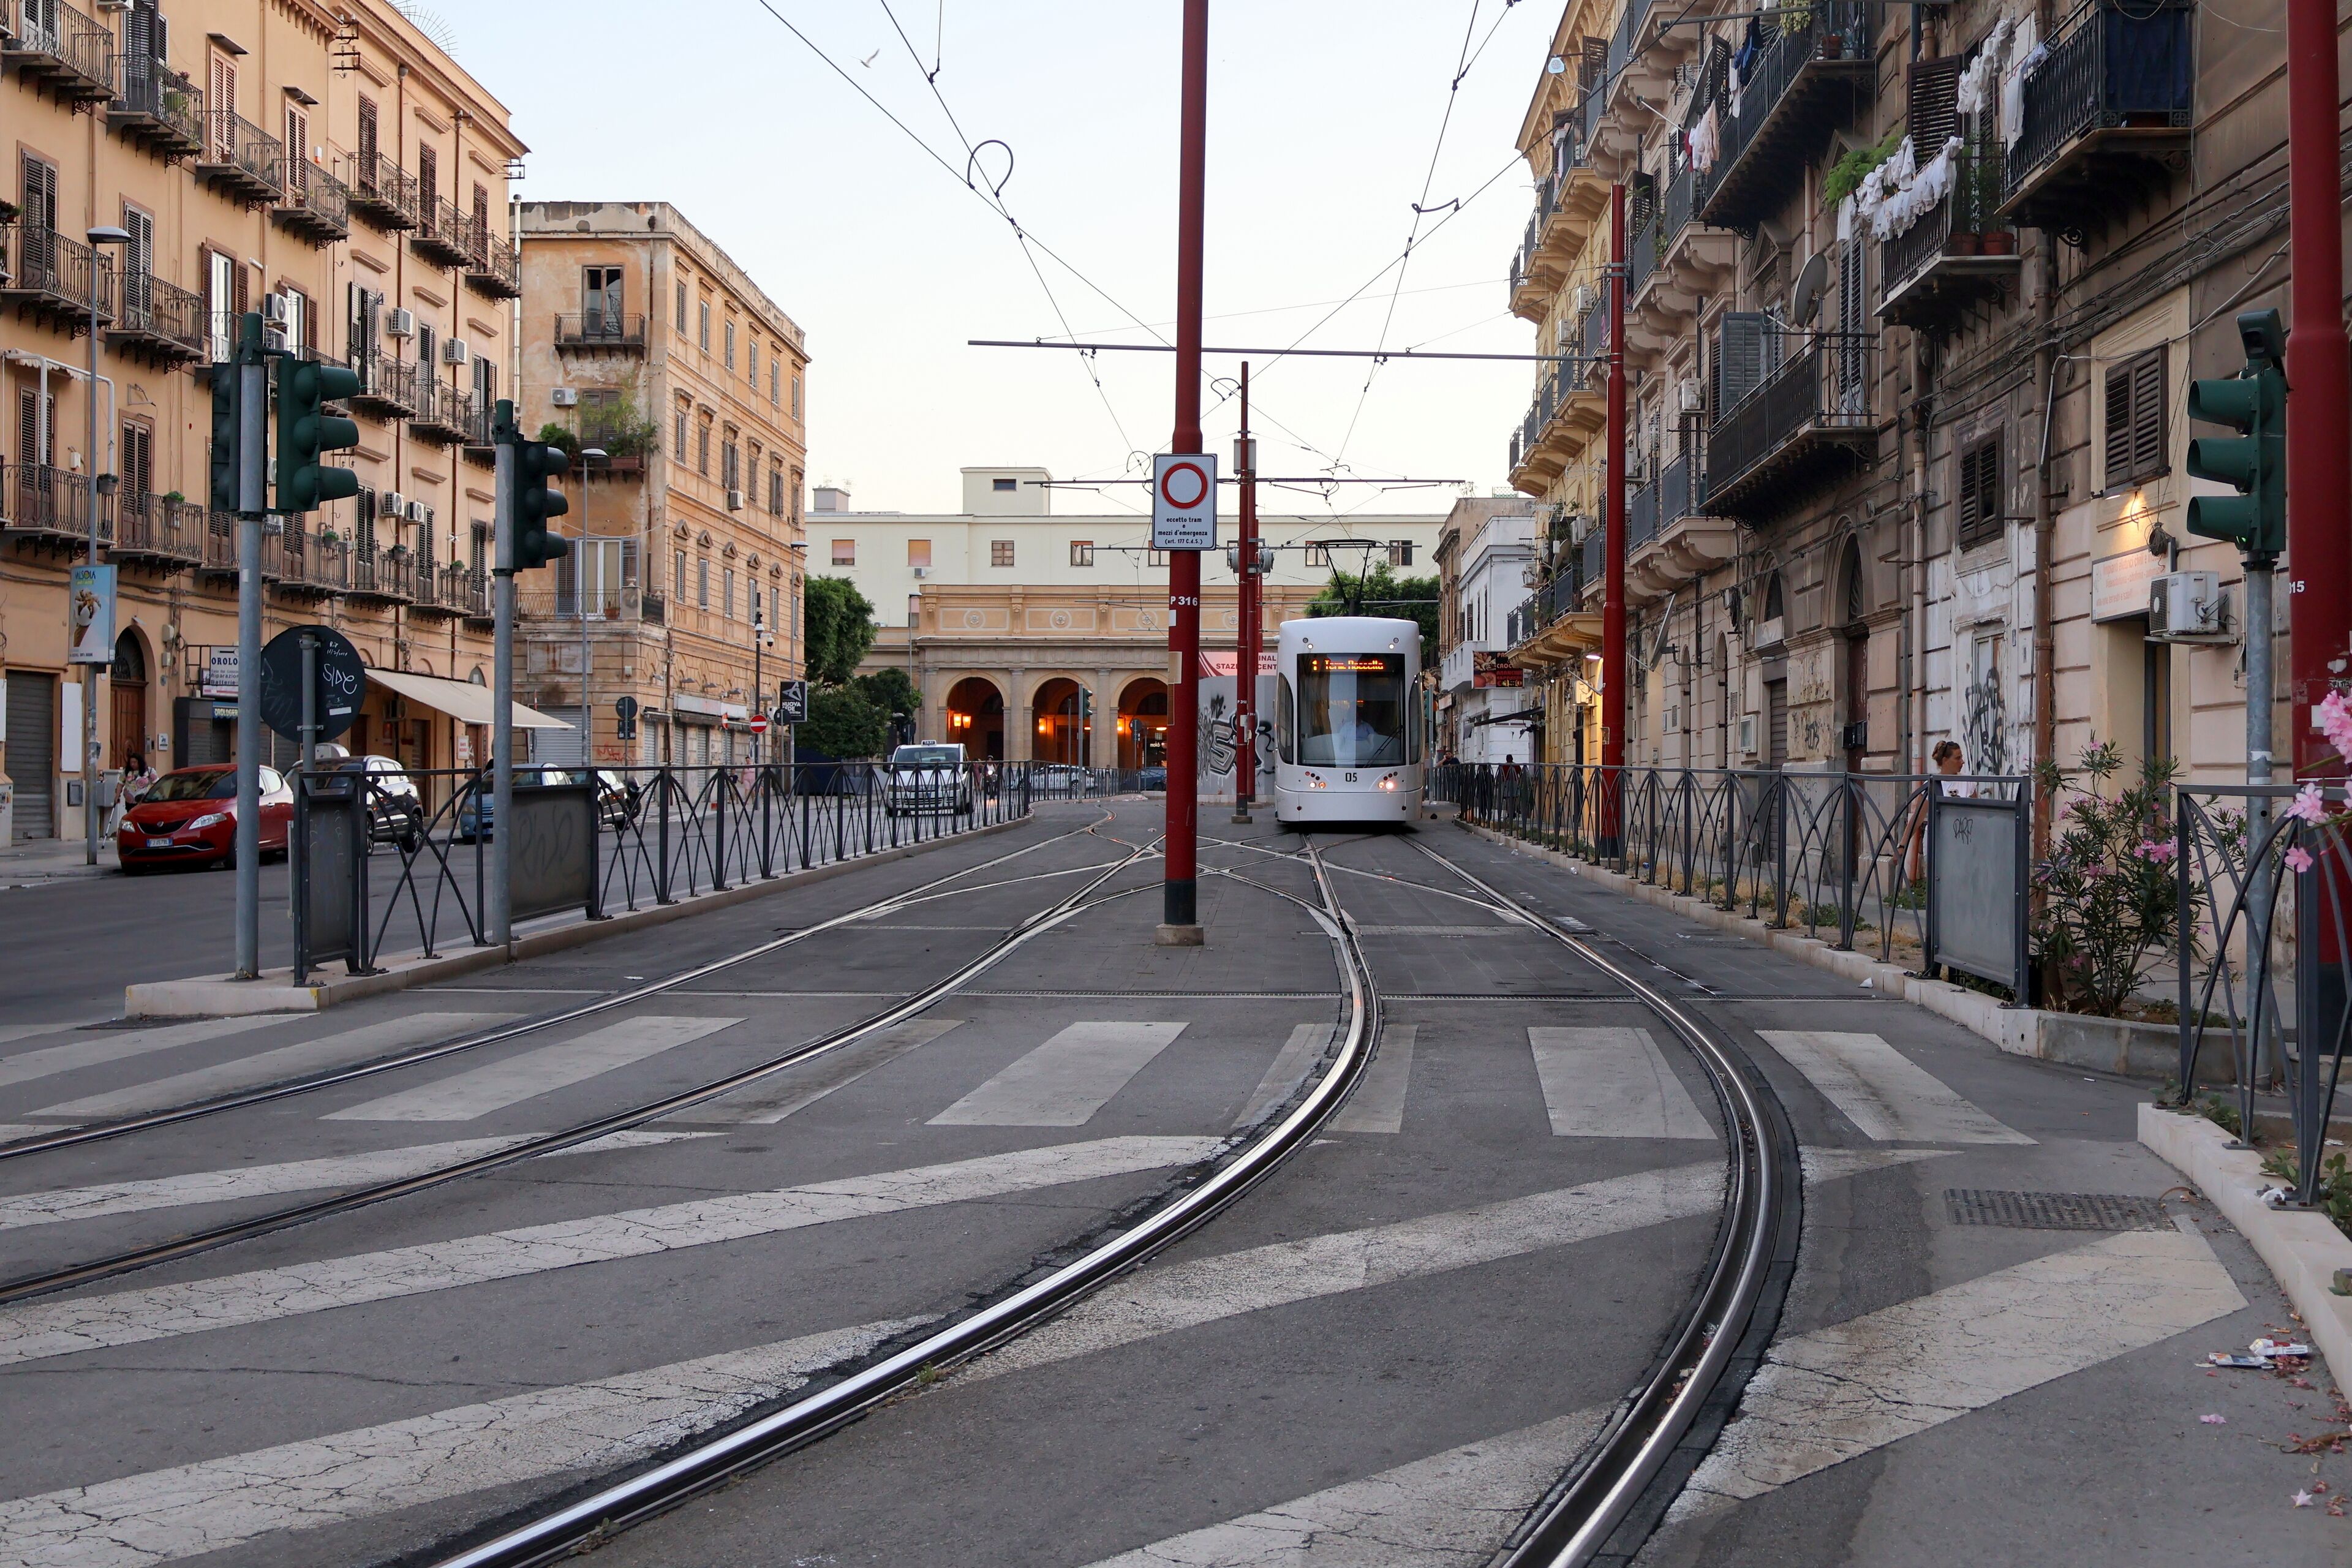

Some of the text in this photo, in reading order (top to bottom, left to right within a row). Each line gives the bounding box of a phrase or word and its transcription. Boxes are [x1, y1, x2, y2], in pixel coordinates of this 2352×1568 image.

[1170, 596, 1198, 606] P 316
[1346, 772, 1357, 782] 05
